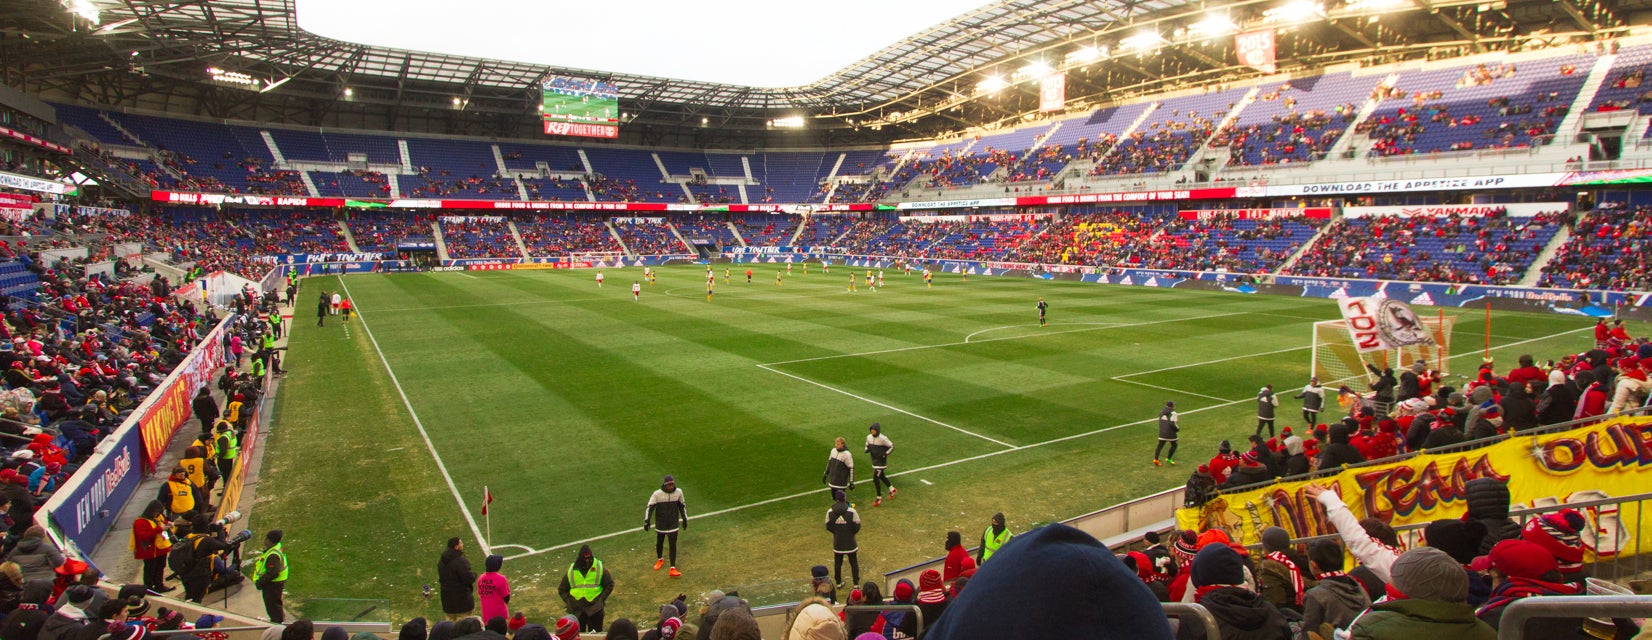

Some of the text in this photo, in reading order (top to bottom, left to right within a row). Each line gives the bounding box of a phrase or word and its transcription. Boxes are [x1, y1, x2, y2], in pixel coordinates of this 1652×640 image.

[1237, 33, 1271, 52] 2015
[571, 124, 605, 136] TOGETHER
[1303, 177, 1505, 193] DOWNLOAD THE APPETIZE APP
[277, 198, 307, 206] RAPIDS
[1098, 194, 1112, 202] FROM
[1113, 193, 1122, 201] THE
[1123, 192, 1148, 200] COMFORT
[1157, 191, 1173, 199] YOUR
[1196, 210, 1212, 220] LUIS
[335, 251, 383, 262] TOGETHER
[187, 464, 195, 475] 9
[876, 469, 882, 477] 7
[1354, 453, 1510, 526] TEAM
[76, 492, 91, 535] NEW
[90, 474, 106, 517] YORK
